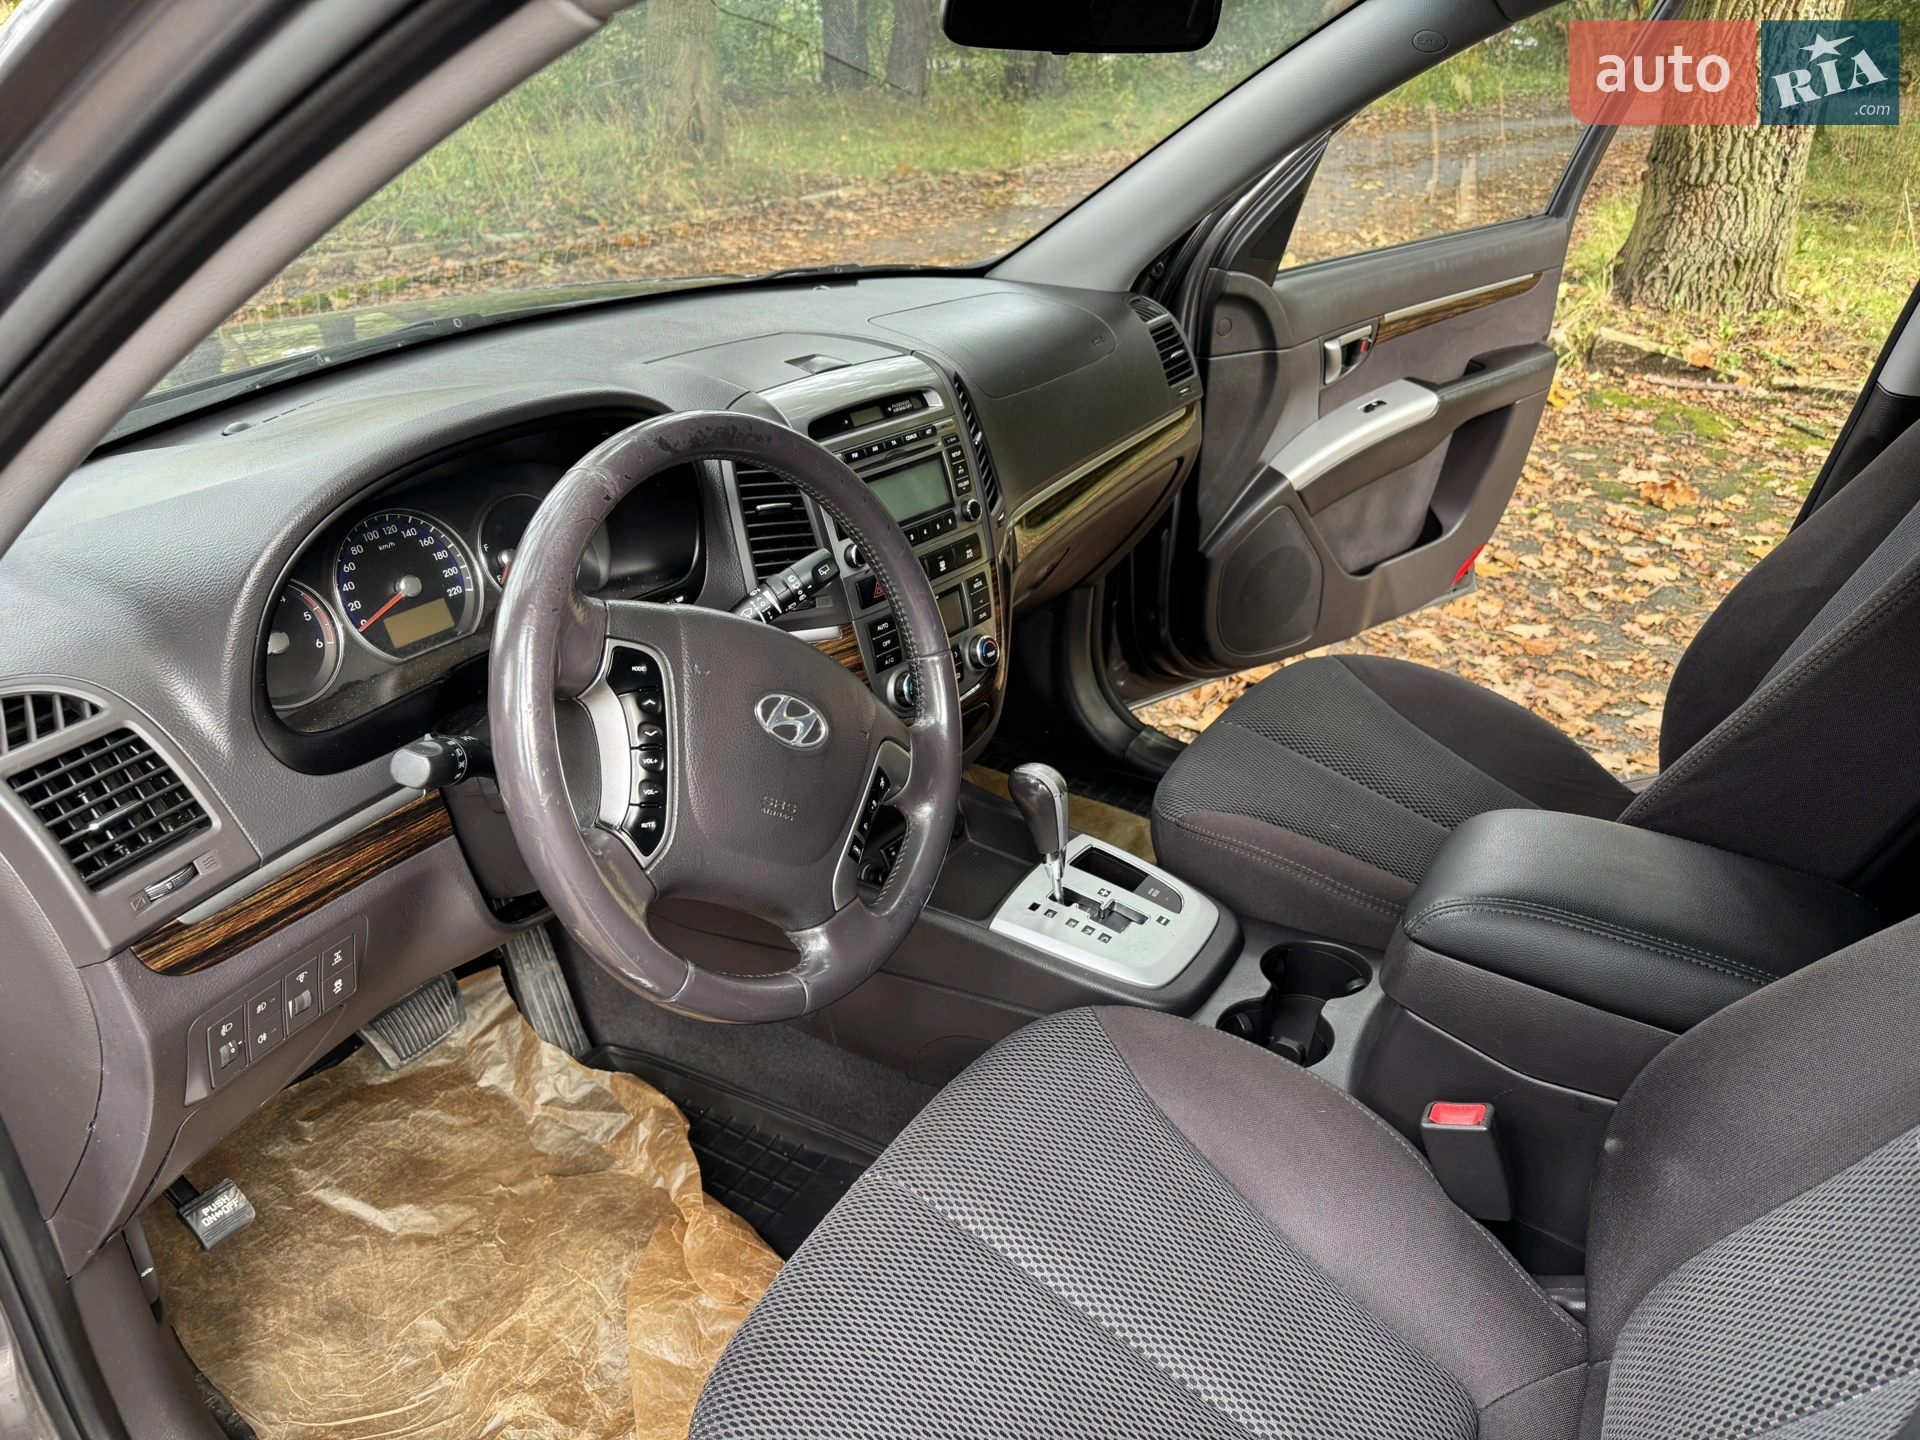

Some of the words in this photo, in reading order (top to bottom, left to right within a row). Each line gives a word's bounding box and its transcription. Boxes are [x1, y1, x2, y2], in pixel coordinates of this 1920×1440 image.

[362, 530, 380, 542] 100
[382, 524, 398, 536] 120
[401, 527, 417, 539] 140
[378, 541, 396, 551] km/h
[419, 536, 434, 548] 160
[483, 543, 489, 552] F
[350, 544, 364, 556] 80
[433, 550, 449, 561] 180
[343, 561, 356, 573] 60
[442, 566, 459, 578] 200
[342, 581, 355, 592] 40
[446, 585, 463, 597] 220
[347, 600, 362, 612] 20
[303, 611, 312, 621] 5
[877, 622, 889, 631] AUTO
[315, 638, 324, 649] 6
[882, 639, 891, 647] OFF
[884, 657, 895, 666] A/C
[201, 1194, 231, 1217] PUSH
[201, 1213, 218, 1227] ON
[221, 1197, 239, 1214] OFF
